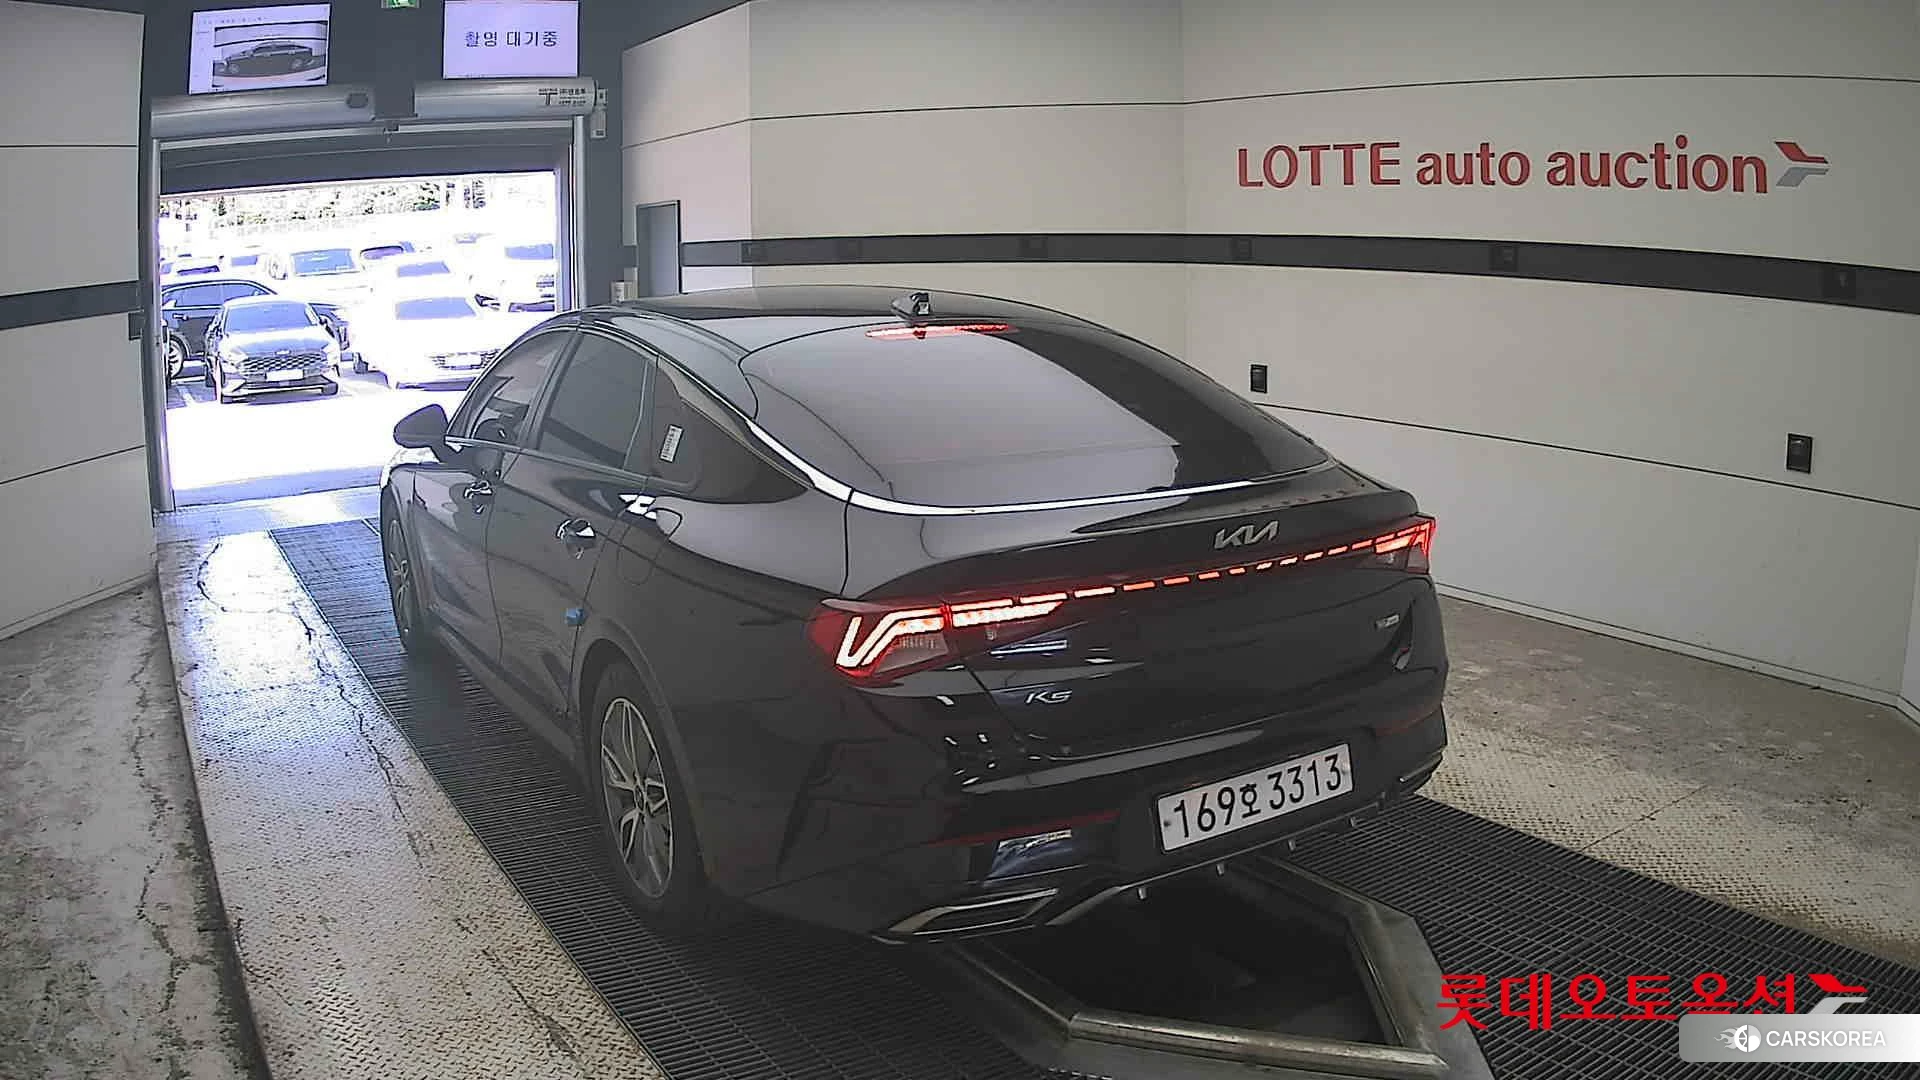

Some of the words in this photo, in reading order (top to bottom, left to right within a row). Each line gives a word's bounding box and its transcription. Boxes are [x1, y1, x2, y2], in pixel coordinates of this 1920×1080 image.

[506, 30, 558, 48] 대기중
[1236, 142, 1400, 188] LOTTE
[1416, 143, 1531, 186] auto
[1546, 134, 1768, 194] auction
[1025, 690, 1073, 704] K5
[1267, 753, 1342, 810] 3313
